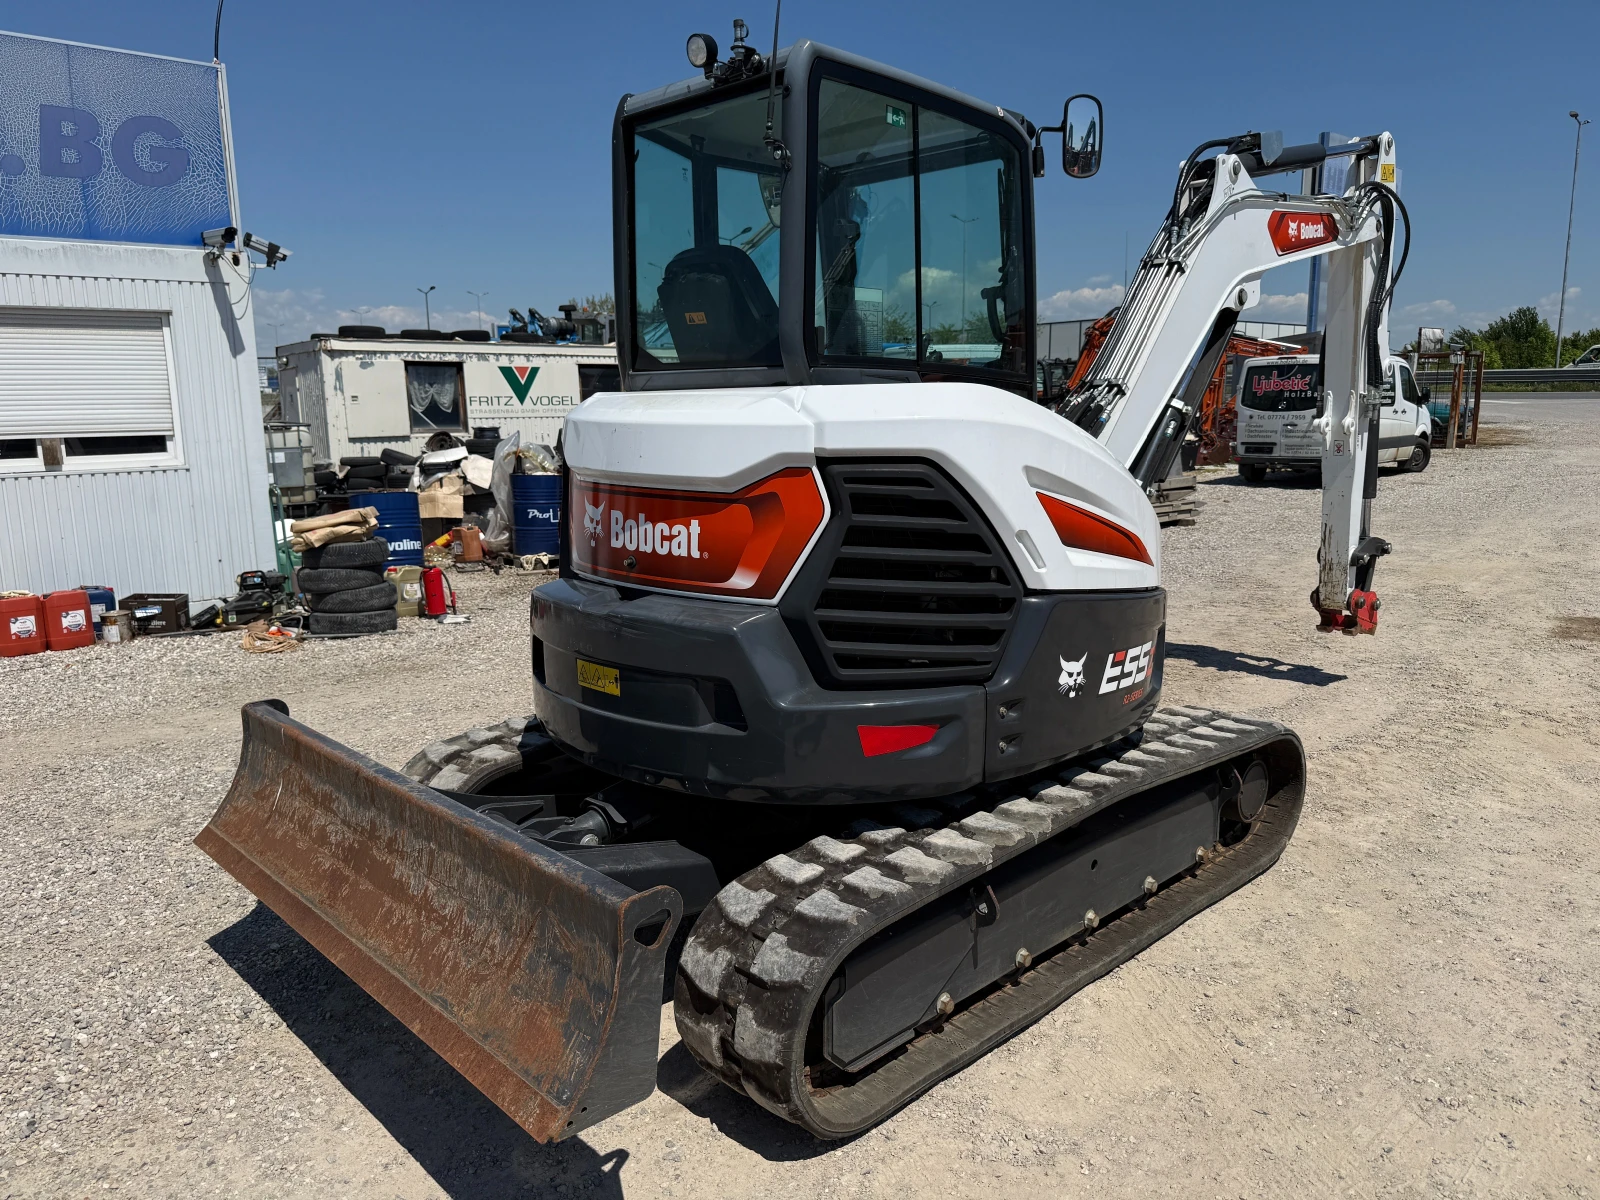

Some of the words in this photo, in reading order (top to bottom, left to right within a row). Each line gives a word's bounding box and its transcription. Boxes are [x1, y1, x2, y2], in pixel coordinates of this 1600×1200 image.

[1300, 221, 1324, 239] Bobcat
[1252, 371, 1312, 397] Ljubetić
[469, 396, 514, 406] FRITZ
[529, 396, 578, 406] VOGEL
[527, 508, 561, 523] ProLi
[610, 509, 701, 559] Bobcat
[388, 539, 422, 551] voline
